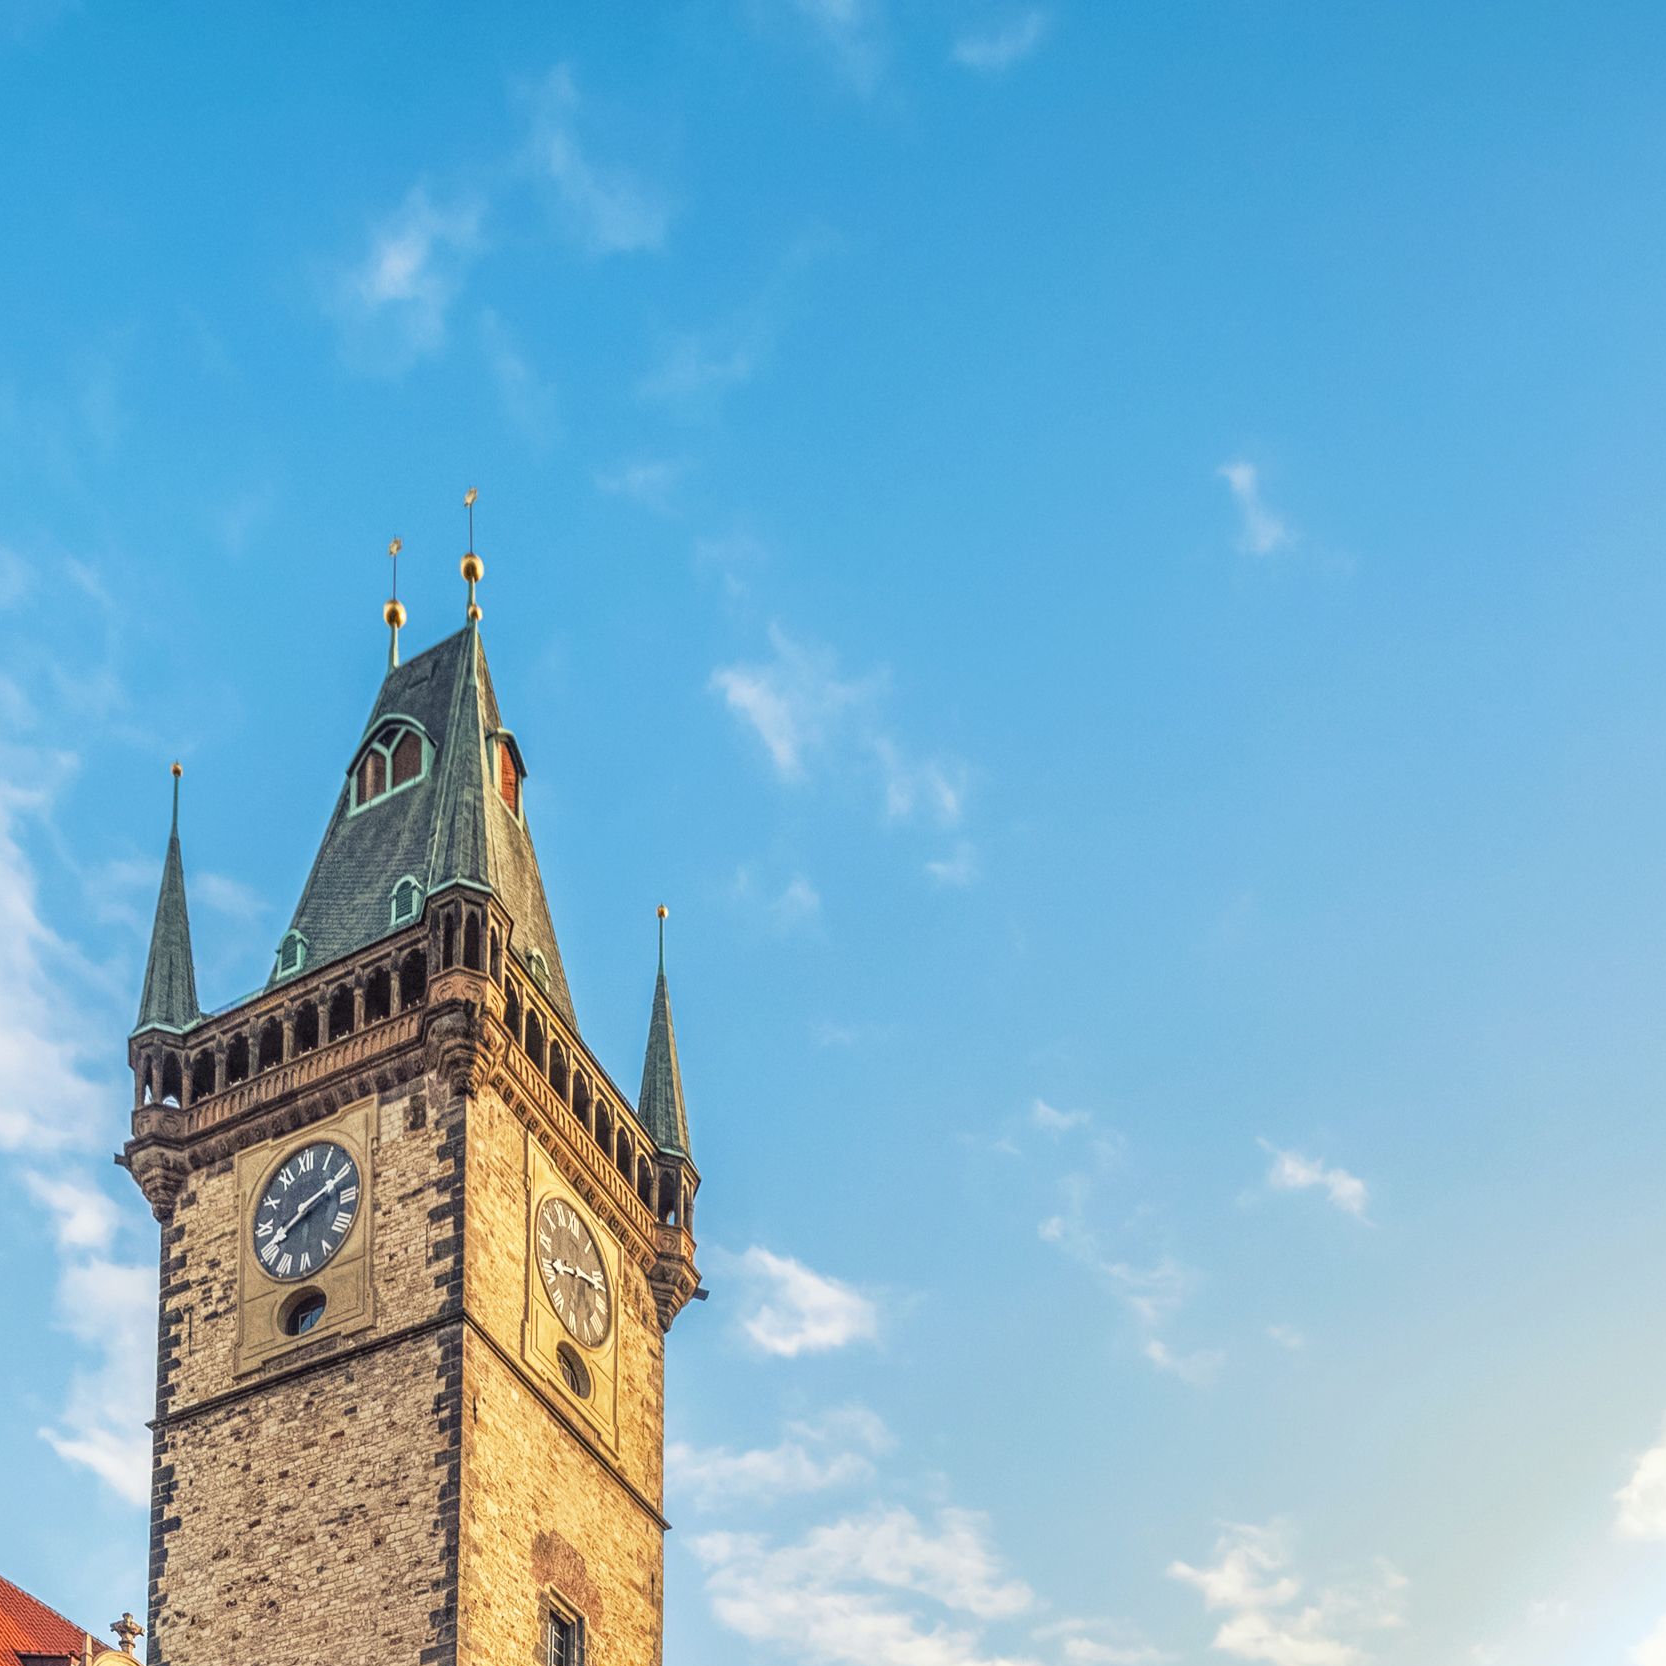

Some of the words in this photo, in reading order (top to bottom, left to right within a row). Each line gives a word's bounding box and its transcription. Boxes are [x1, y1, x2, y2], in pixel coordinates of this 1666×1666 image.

[297, 1151, 314, 1176] XII
[322, 1151, 333, 1171] I
[278, 1167, 295, 1191] XI
[264, 1195, 281, 1211] X
[340, 1185, 356, 1205] III
[257, 1218, 273, 1238] IX
[331, 1211, 352, 1233] IIII
[321, 1239, 333, 1256] V
[276, 1252, 293, 1274] VII
[299, 1252, 311, 1272] VI
